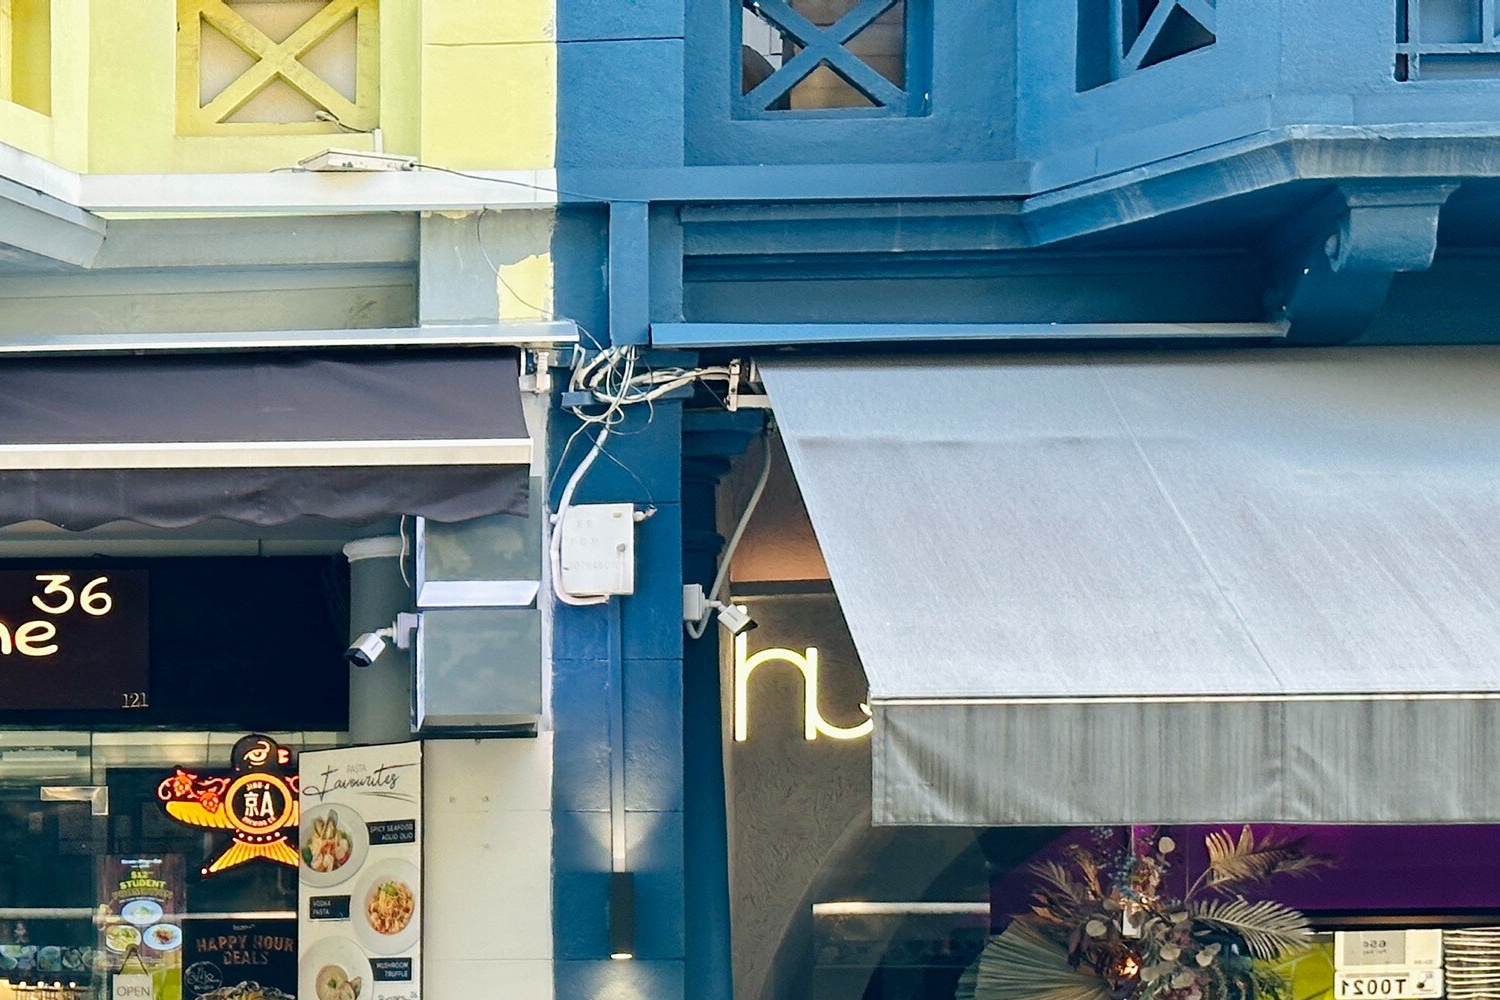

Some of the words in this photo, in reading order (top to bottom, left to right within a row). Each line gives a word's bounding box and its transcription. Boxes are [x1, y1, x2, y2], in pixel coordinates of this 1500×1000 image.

[734, 605, 874, 742] hu
[121, 693, 149, 708] 121
[120, 879, 166, 890] STUDENT
[196, 934, 247, 952] HAPPY
[253, 934, 294, 953] HOUR
[223, 951, 269, 965] DEALS
[116, 986, 151, 997] OPEN
